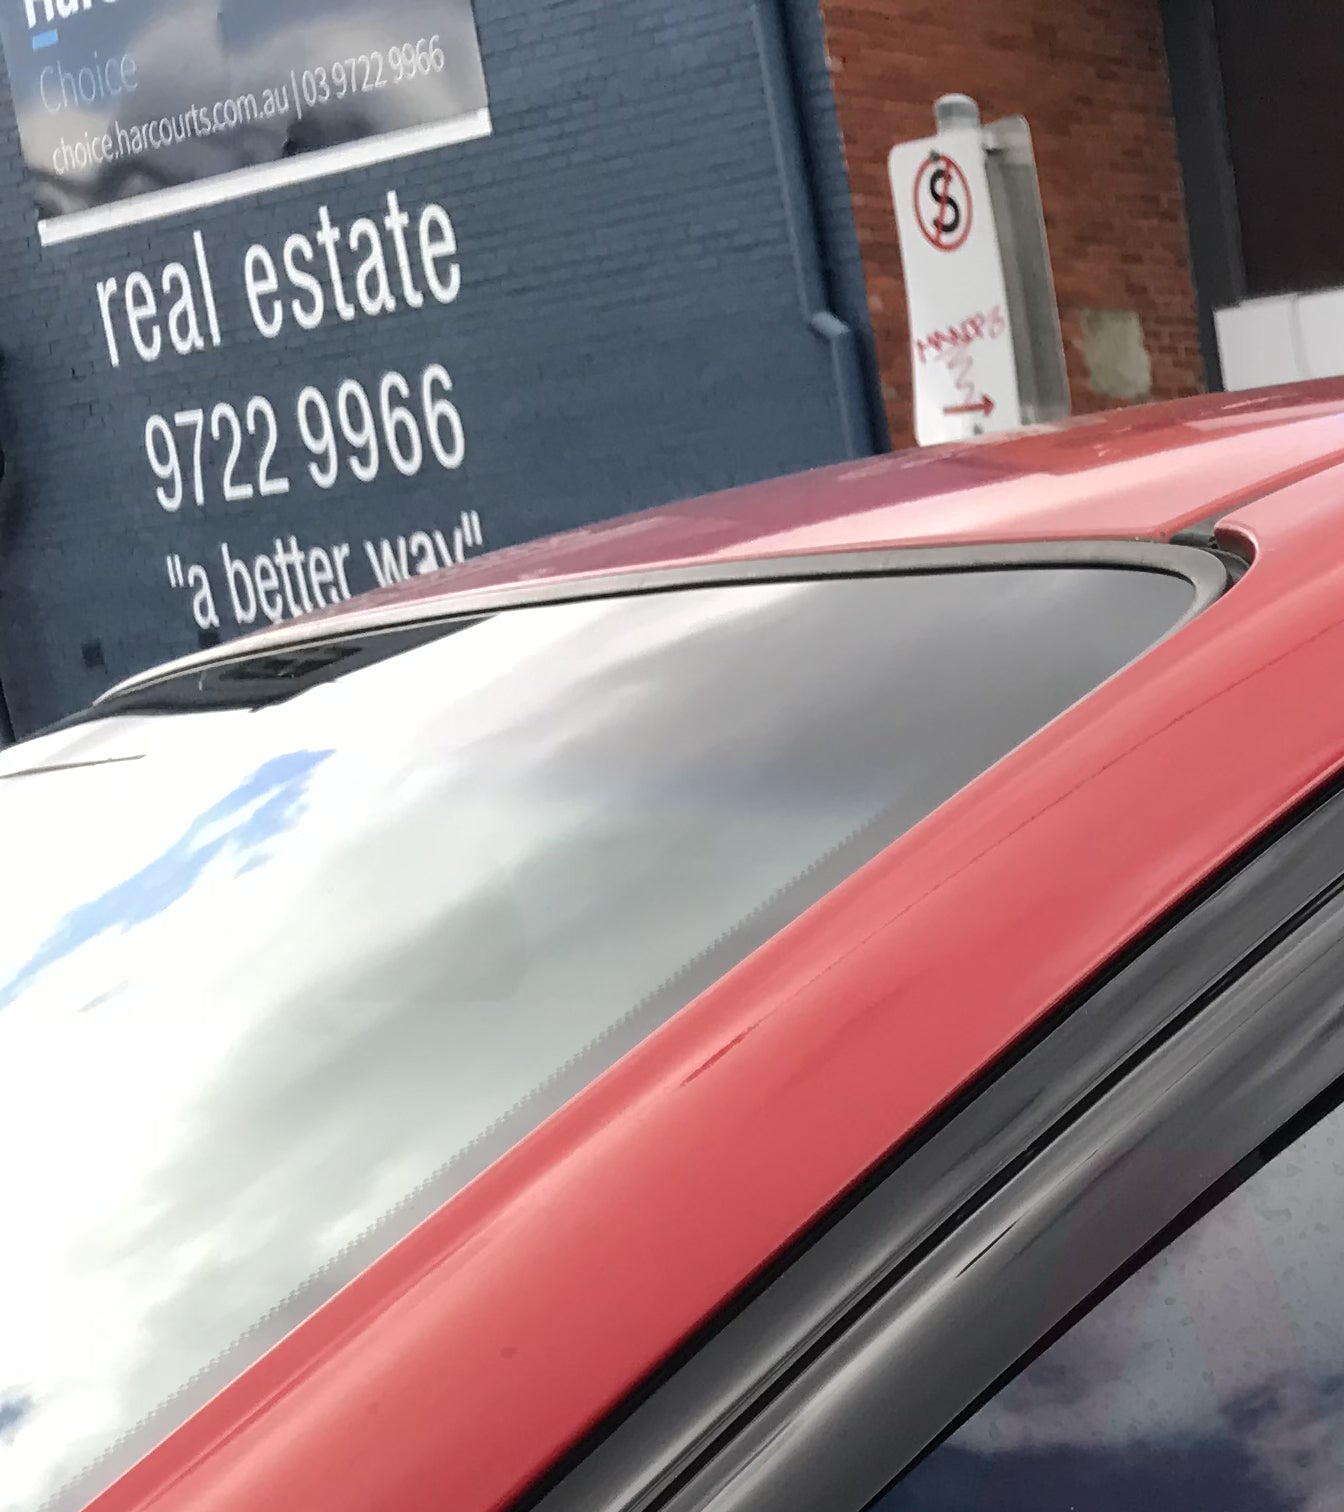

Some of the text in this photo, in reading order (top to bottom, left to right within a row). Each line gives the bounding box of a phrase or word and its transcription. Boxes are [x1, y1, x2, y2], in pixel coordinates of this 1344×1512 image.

[40, 50, 138, 115] Choice
[52, 84, 289, 175] choice.harcourts.com.au
[302, 66, 331, 107] 03
[331, 51, 388, 100] 9722
[388, 34, 445, 82] 9966
[96, 190, 462, 368] real estate
[145, 364, 466, 513] 9722 9966
[166, 554, 221, 630] "a
[220, 533, 352, 625] better
